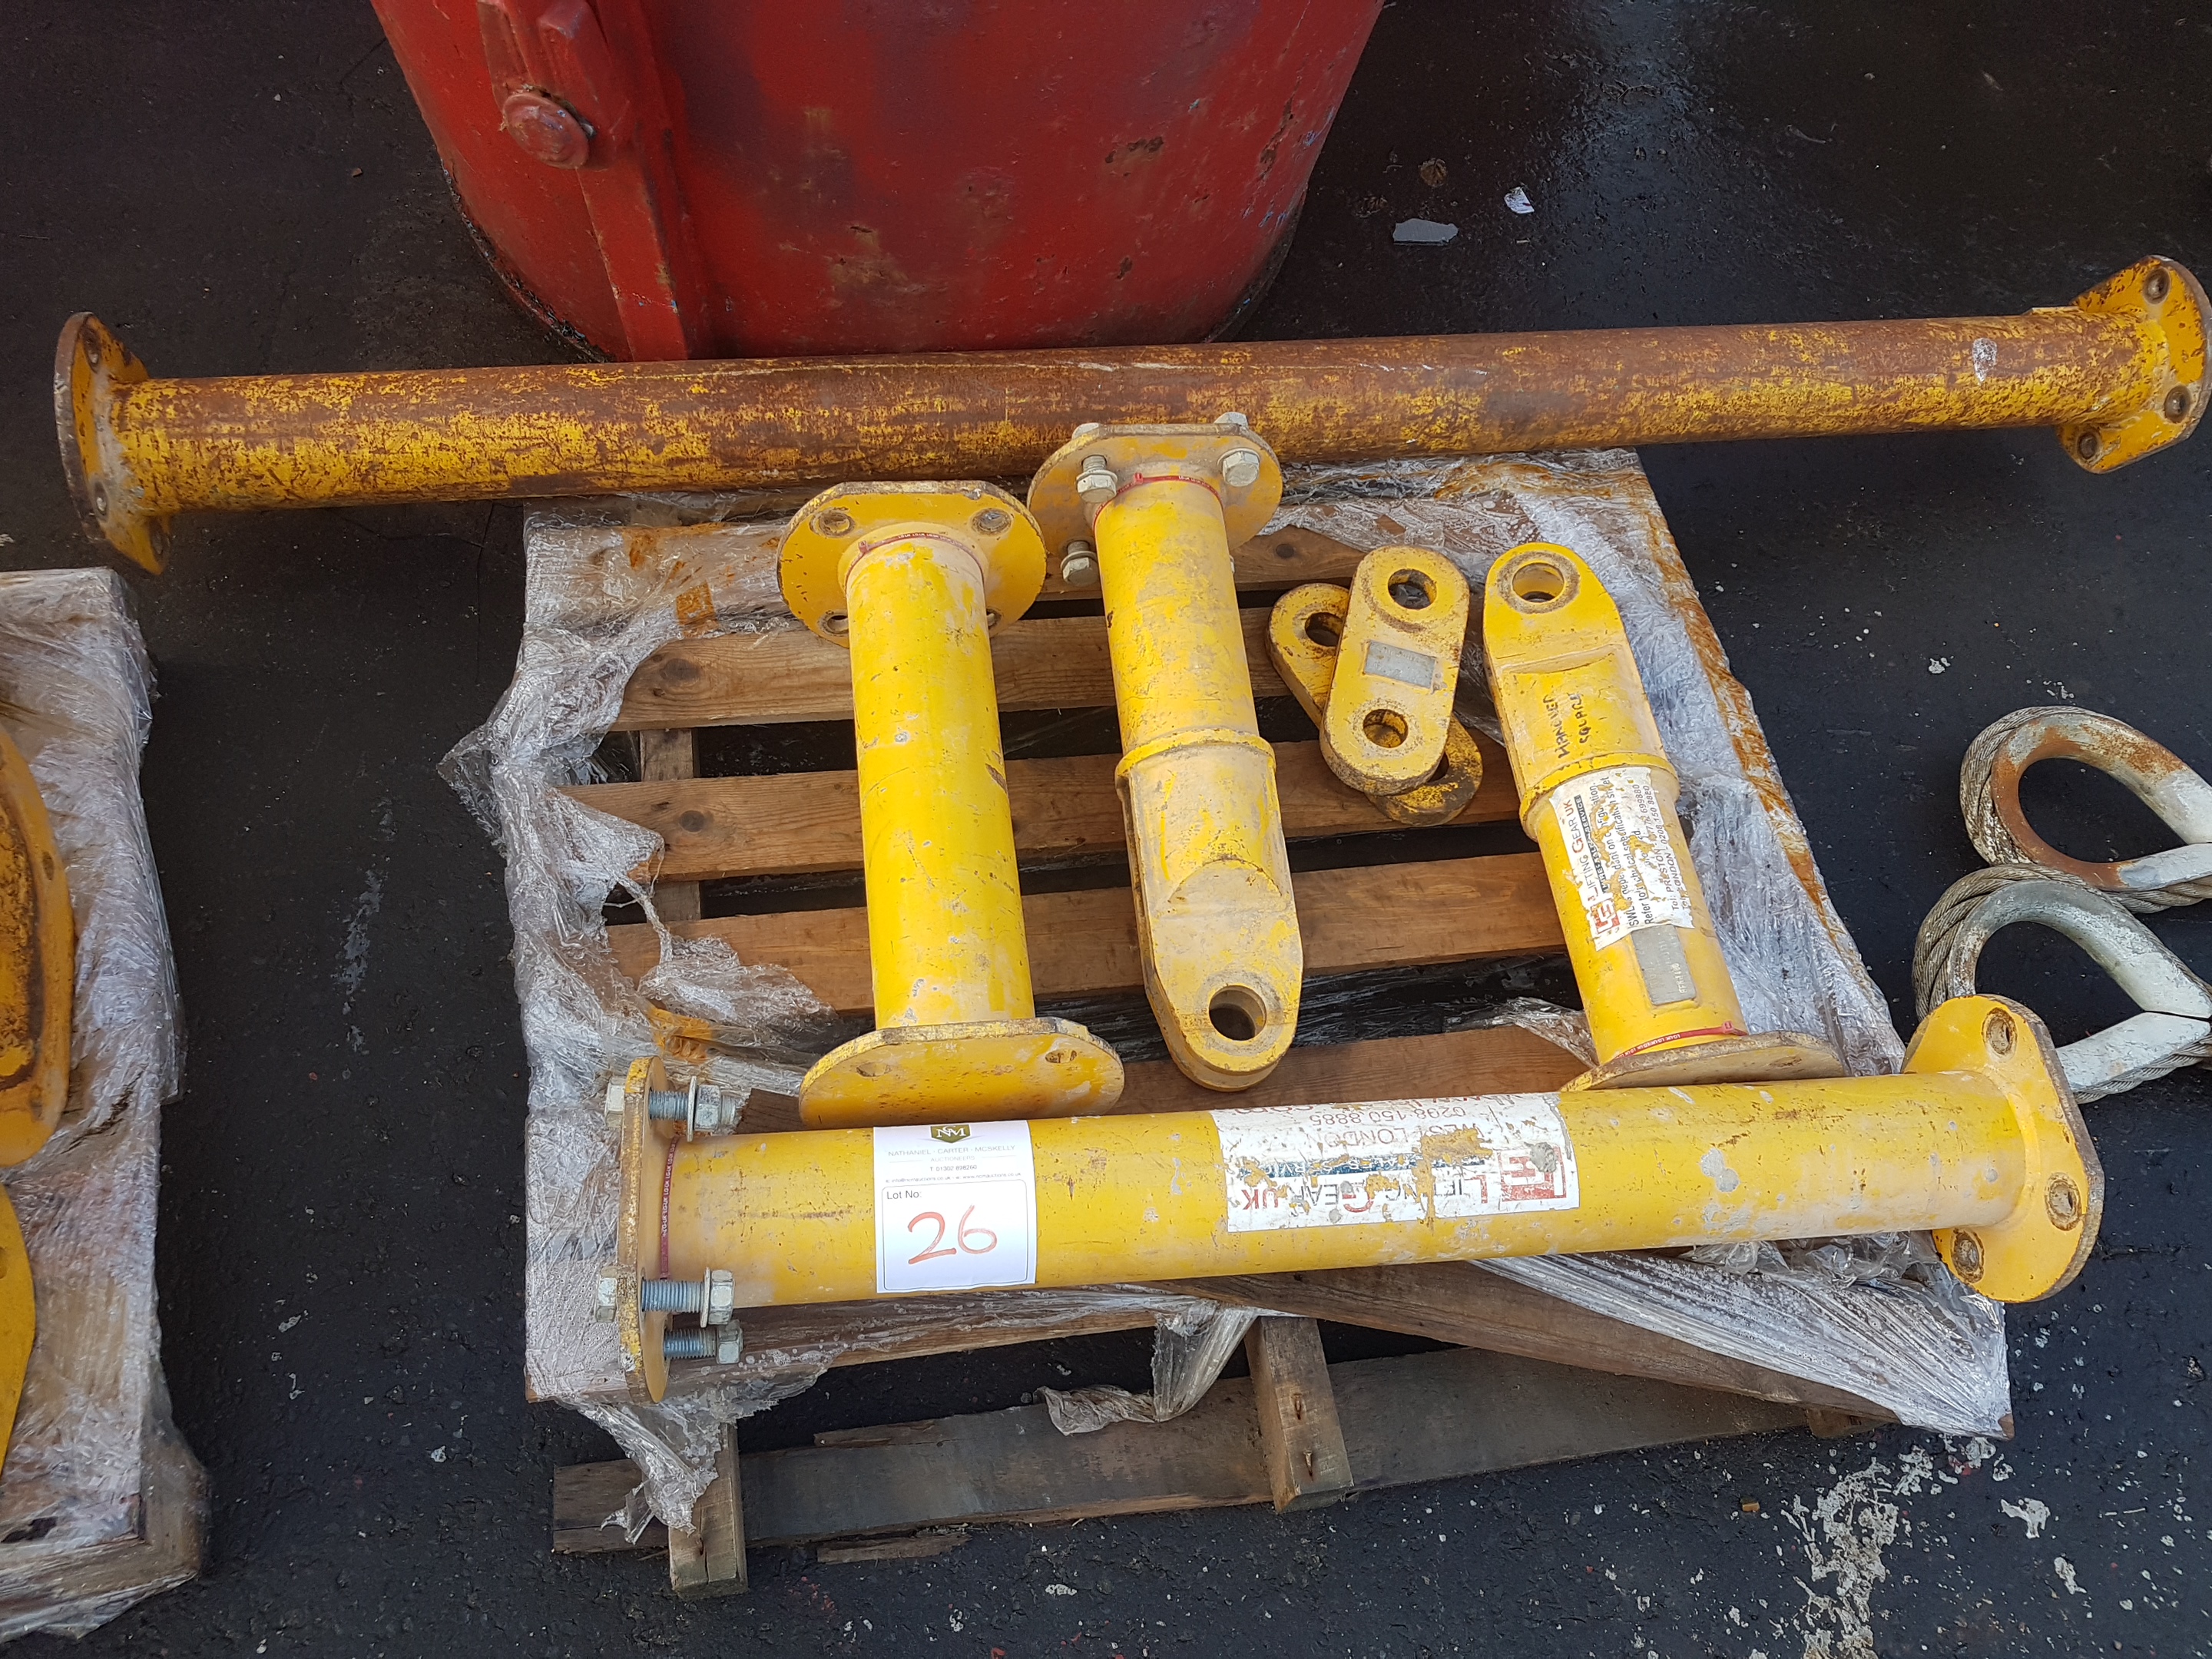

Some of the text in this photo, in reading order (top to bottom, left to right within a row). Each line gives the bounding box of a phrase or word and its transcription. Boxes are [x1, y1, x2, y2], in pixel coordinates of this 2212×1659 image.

[1563, 799, 1575, 816] UK
[1575, 797, 1590, 833] SERVICE
[1650, 806, 1660, 821] 150
[1568, 816, 1583, 853] GEAR
[1605, 839, 1615, 849] on
[1638, 891, 1647, 900] to
[1624, 906, 1639, 926] SWL
[1641, 902, 1654, 924] Refer
[1369, 1110, 1406, 1123] 150
[886, 1190, 922, 1200] Lot No:
[1243, 1174, 1488, 1213] LIFTNG GEAR UK
[907, 1204, 998, 1265] 26
